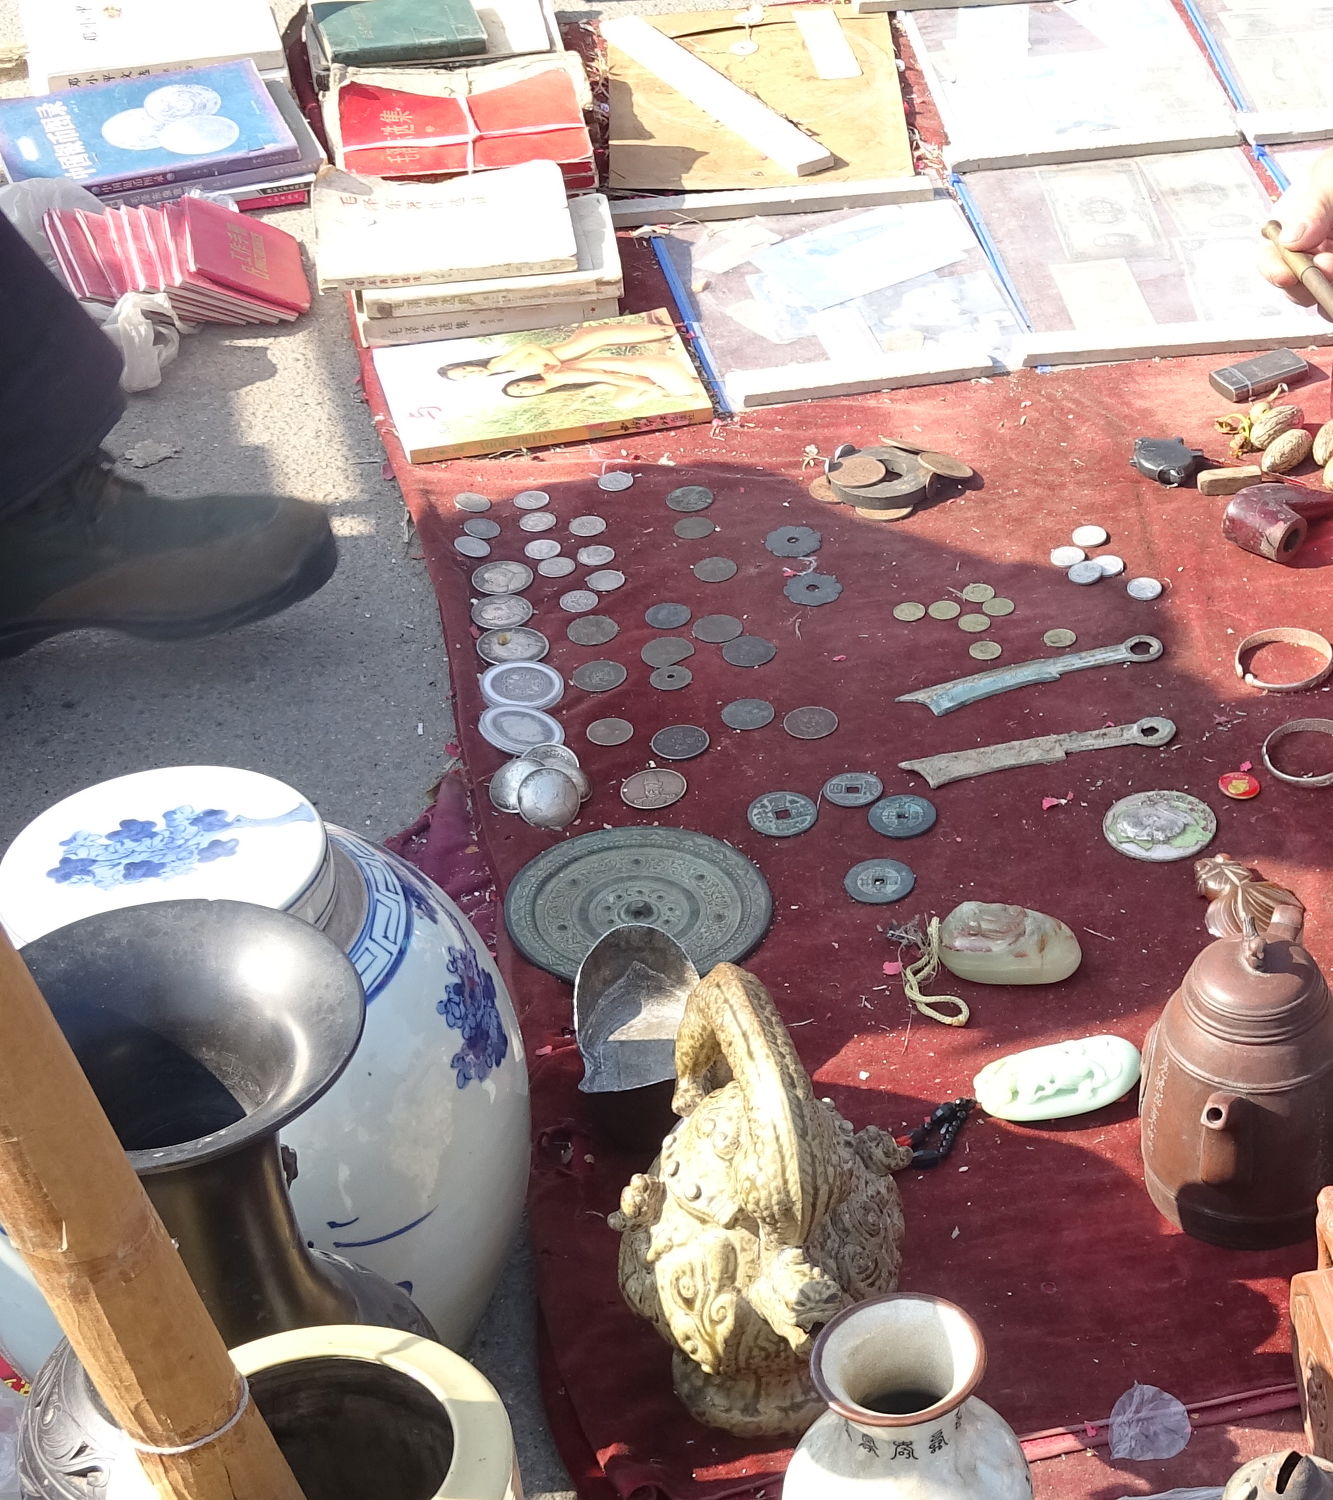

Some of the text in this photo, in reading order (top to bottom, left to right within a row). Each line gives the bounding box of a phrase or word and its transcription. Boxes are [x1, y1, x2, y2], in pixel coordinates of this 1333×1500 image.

[388, 319, 471, 336] 毛泽东选集
